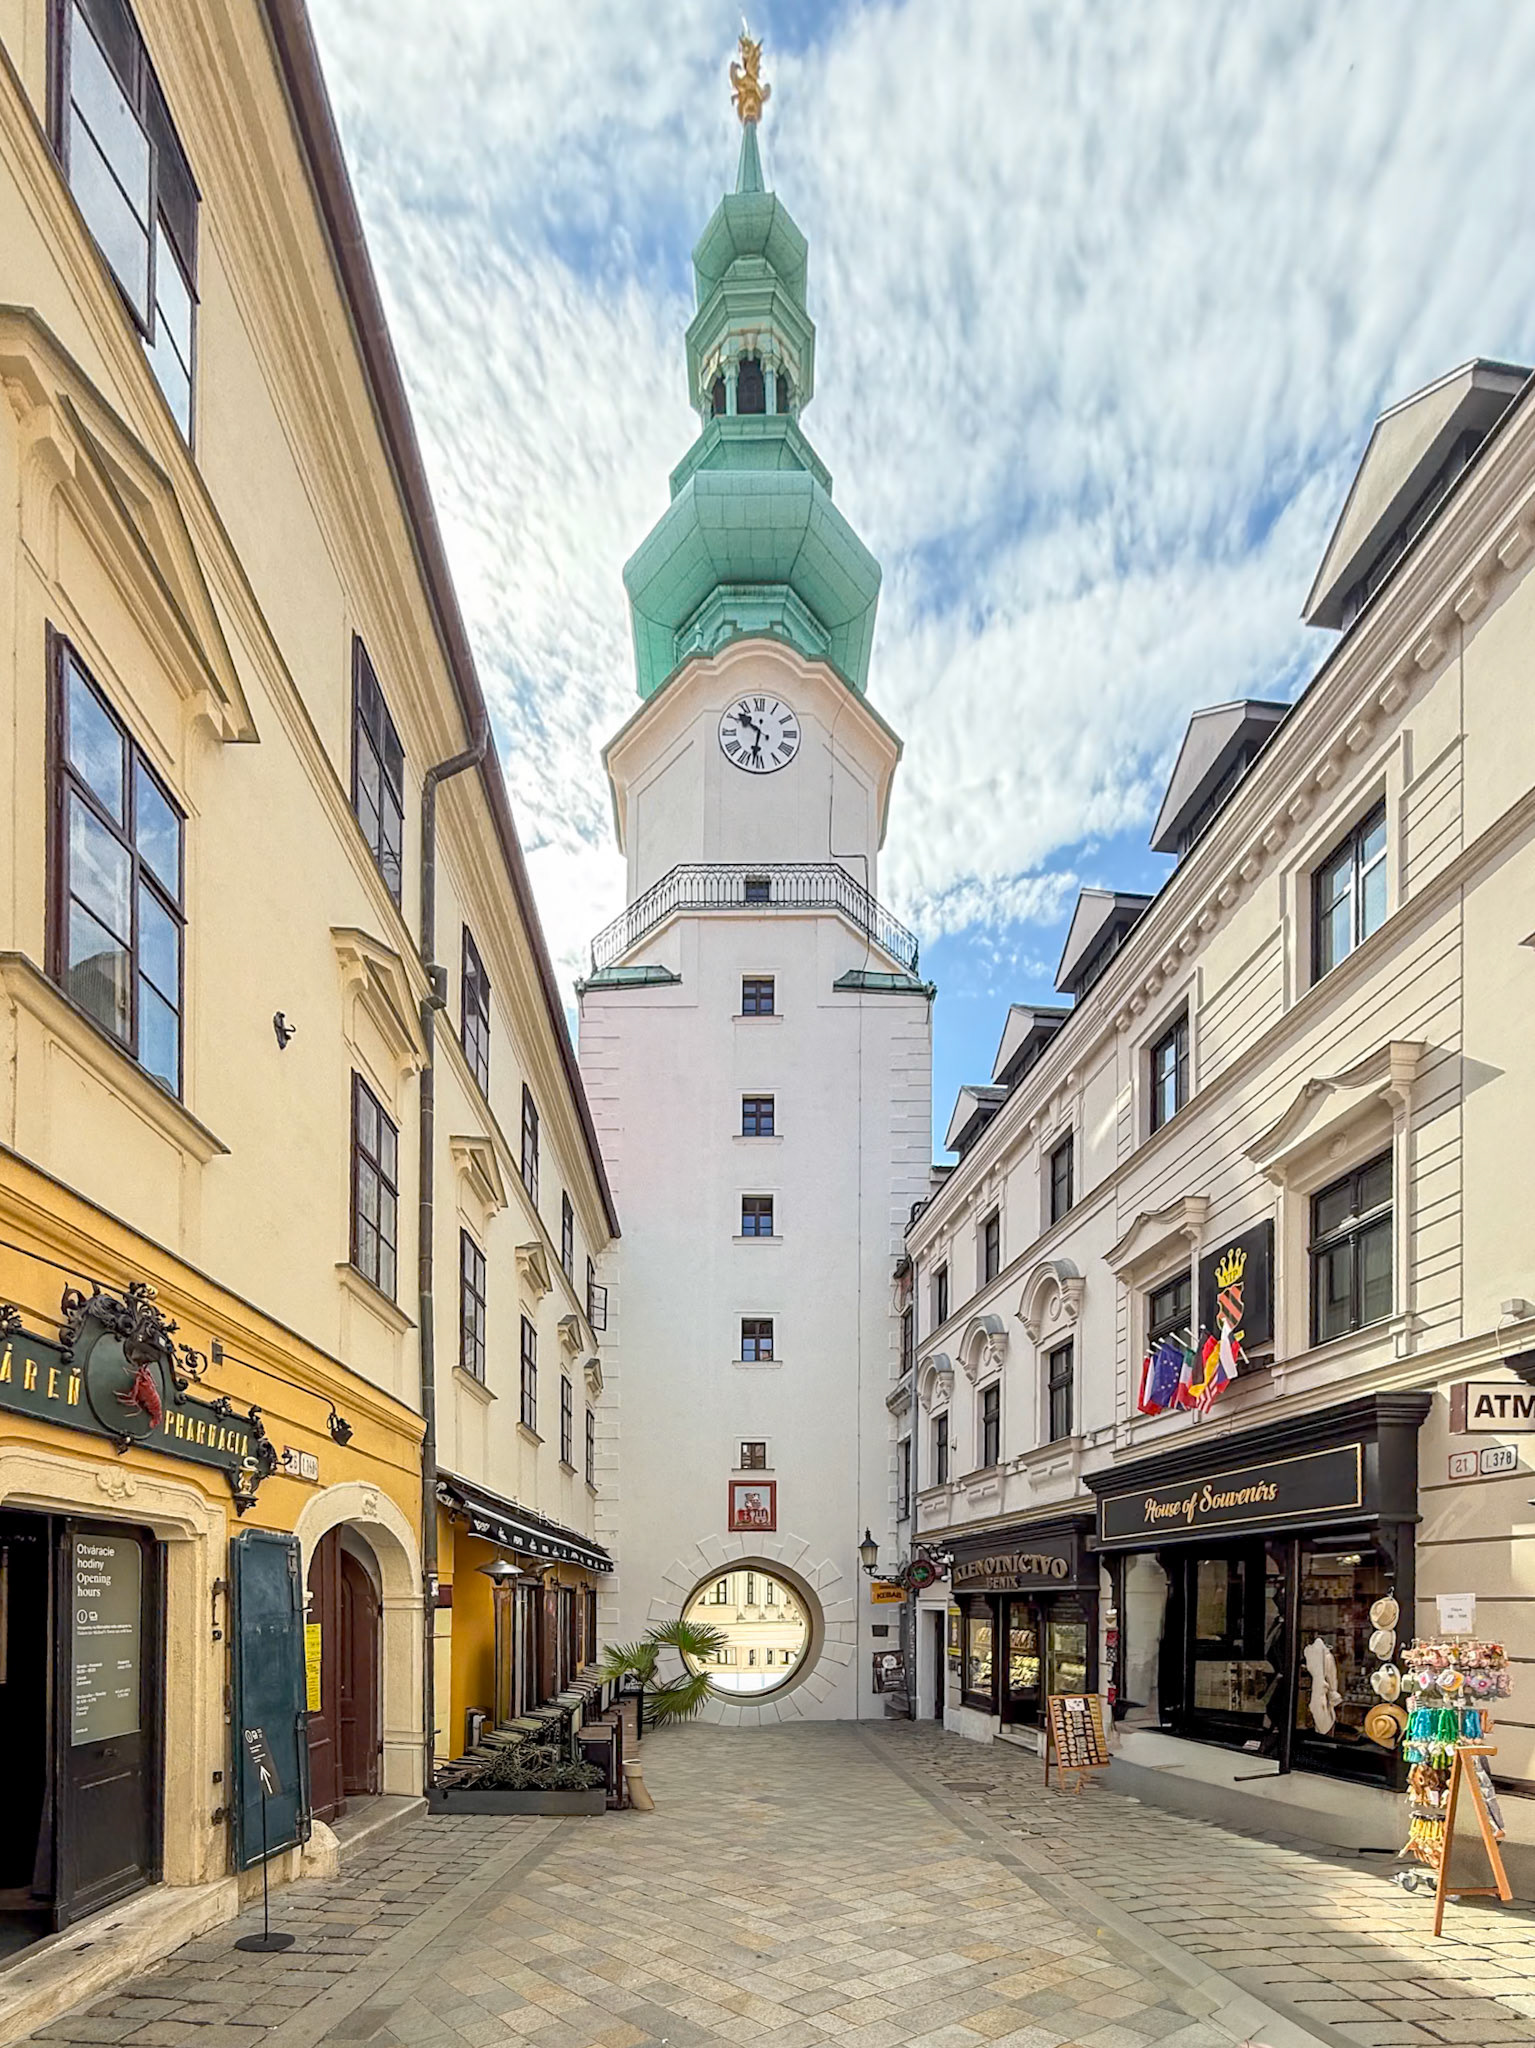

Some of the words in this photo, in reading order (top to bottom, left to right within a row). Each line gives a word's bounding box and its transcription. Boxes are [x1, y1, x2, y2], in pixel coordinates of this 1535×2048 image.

[738, 700, 751, 714] XI
[753, 698, 765, 712] XII
[779, 714, 793, 725] II
[783, 730, 797, 739] III
[1223, 1269, 1239, 1284] VIP
[1474, 1394, 1535, 1418] ATM
[1455, 1458, 1468, 1473] 21
[1144, 1498, 1181, 1523] House
[1182, 1492, 1198, 1524] of
[1199, 1480, 1278, 1512] Souvenirs
[77, 1543, 115, 1557] Otváracie
[77, 1557, 104, 1571] hodiny
[76, 1572, 111, 1586] Opening
[77, 1585, 101, 1597] hours
